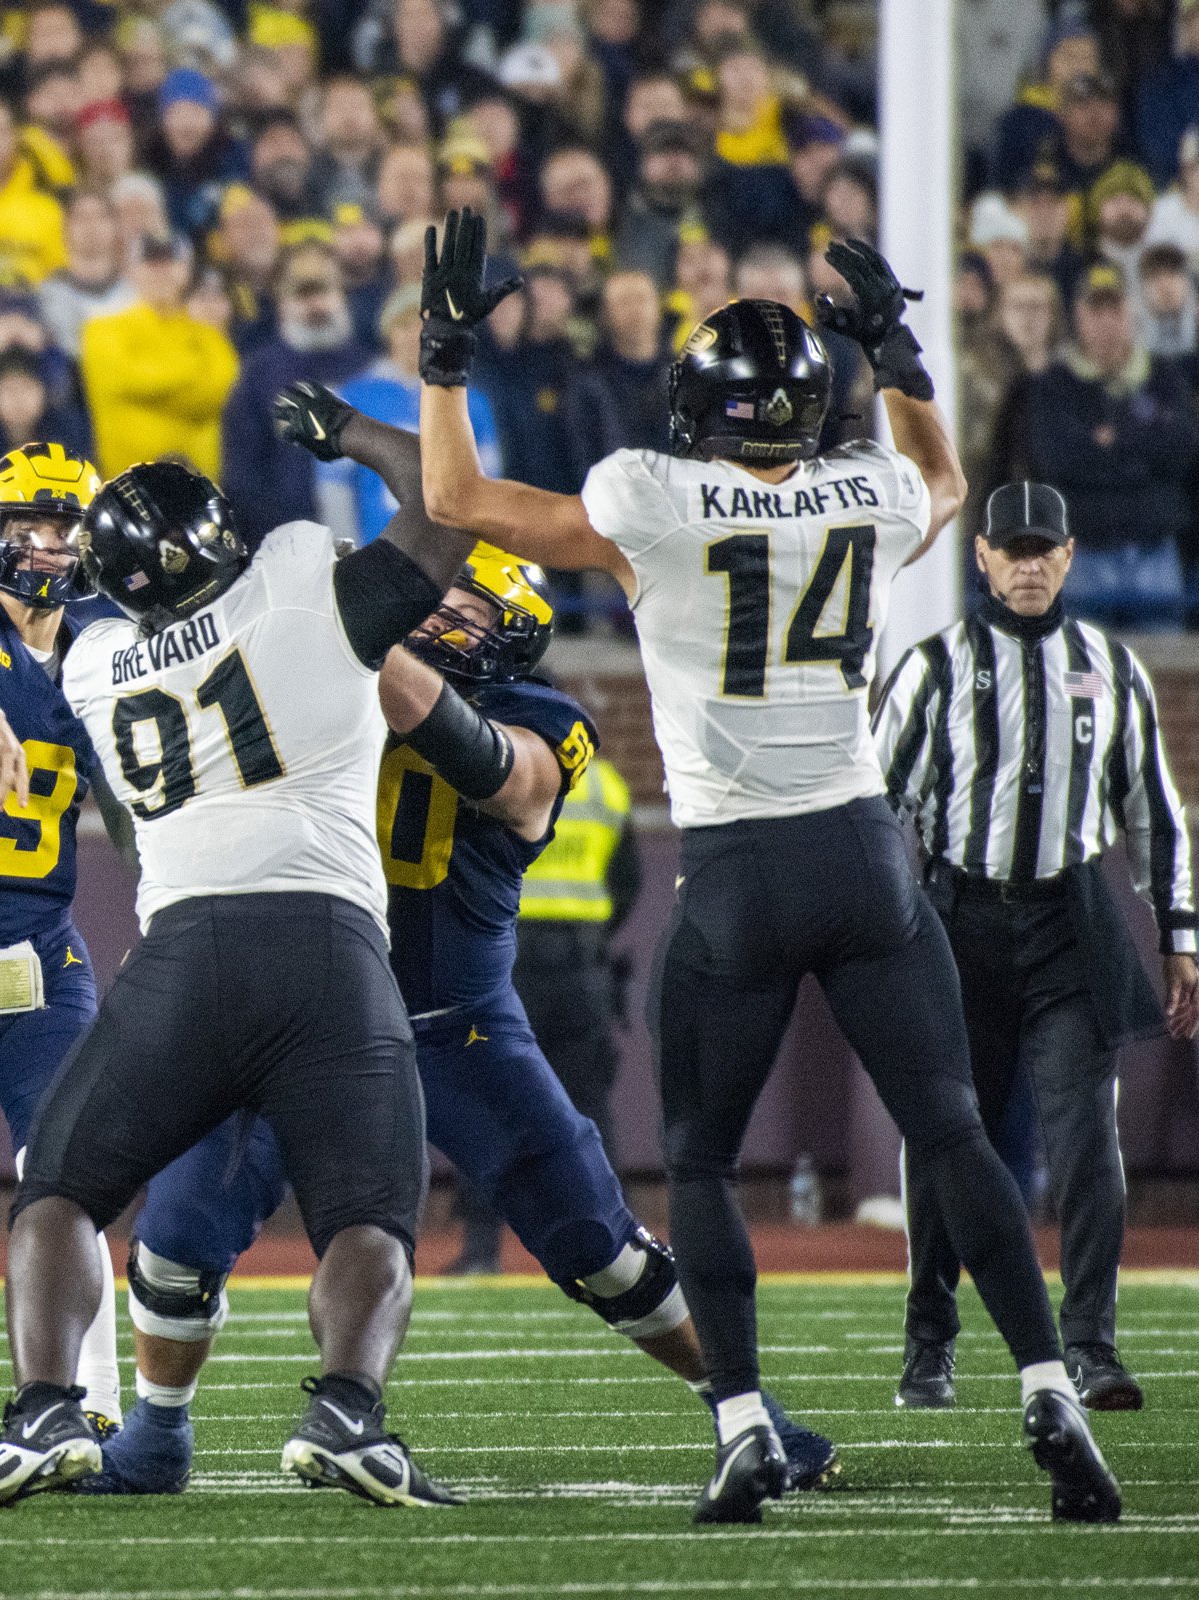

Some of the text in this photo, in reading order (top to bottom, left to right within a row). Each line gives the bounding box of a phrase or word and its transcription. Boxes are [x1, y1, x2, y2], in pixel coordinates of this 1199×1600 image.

[701, 475, 879, 519] KARLAFTIS
[704, 523, 876, 698] 14
[112, 612, 221, 685] BREVARD
[975, 670, 992, 690] S
[111, 641, 287, 822] 91
[1075, 716, 1092, 744] C
